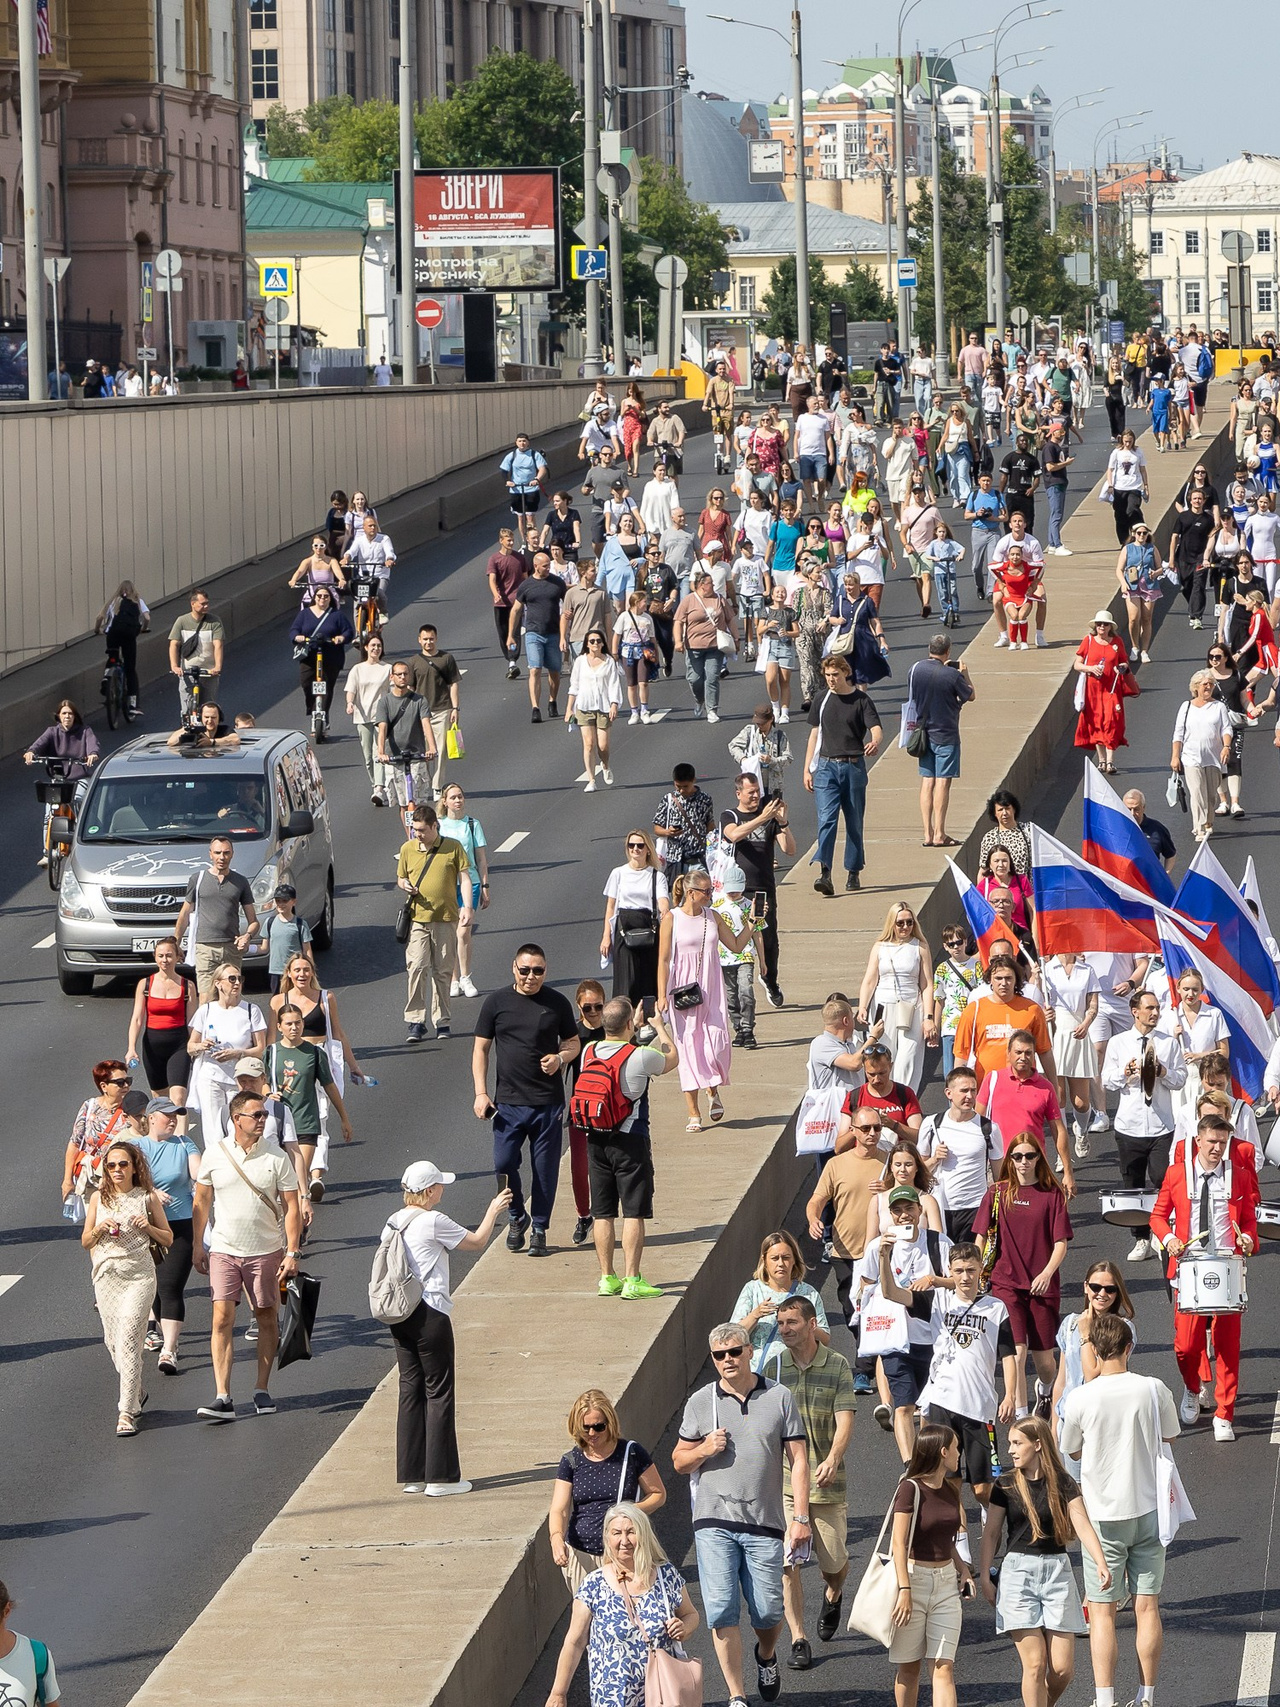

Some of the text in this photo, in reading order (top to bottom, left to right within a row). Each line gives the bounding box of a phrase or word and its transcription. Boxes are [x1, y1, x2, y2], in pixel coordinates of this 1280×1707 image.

[440, 175, 504, 210] ЗВЕРИ
[438, 213, 469, 221] АВГУСТА
[958, 1333, 965, 1343] A
